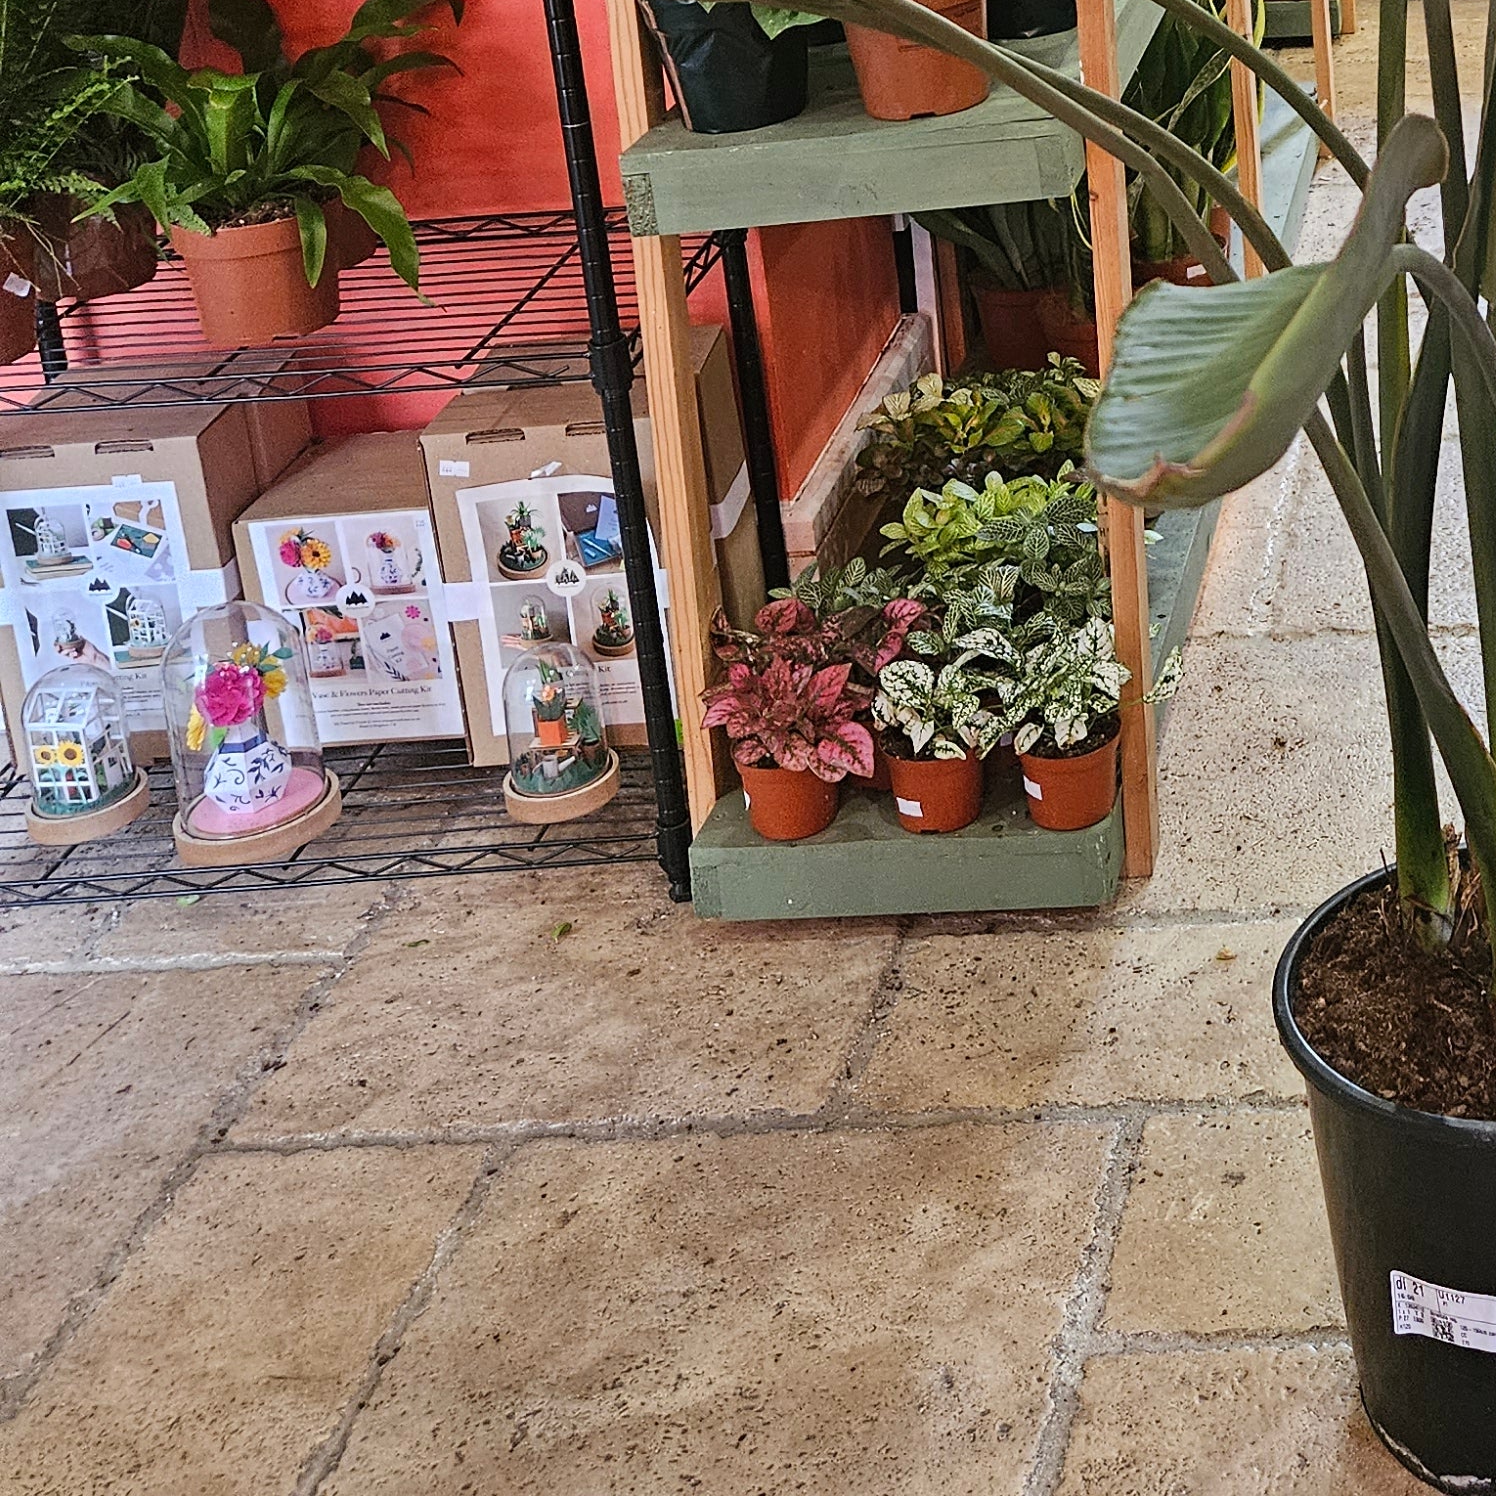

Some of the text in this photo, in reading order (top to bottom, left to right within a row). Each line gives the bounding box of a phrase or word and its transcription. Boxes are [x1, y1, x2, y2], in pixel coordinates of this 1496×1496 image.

[368, 688, 389, 697] Paper
[390, 686, 419, 695] Cutting
[420, 685, 432, 693] Kit
[1412, 1281, 1424, 1297] 21
